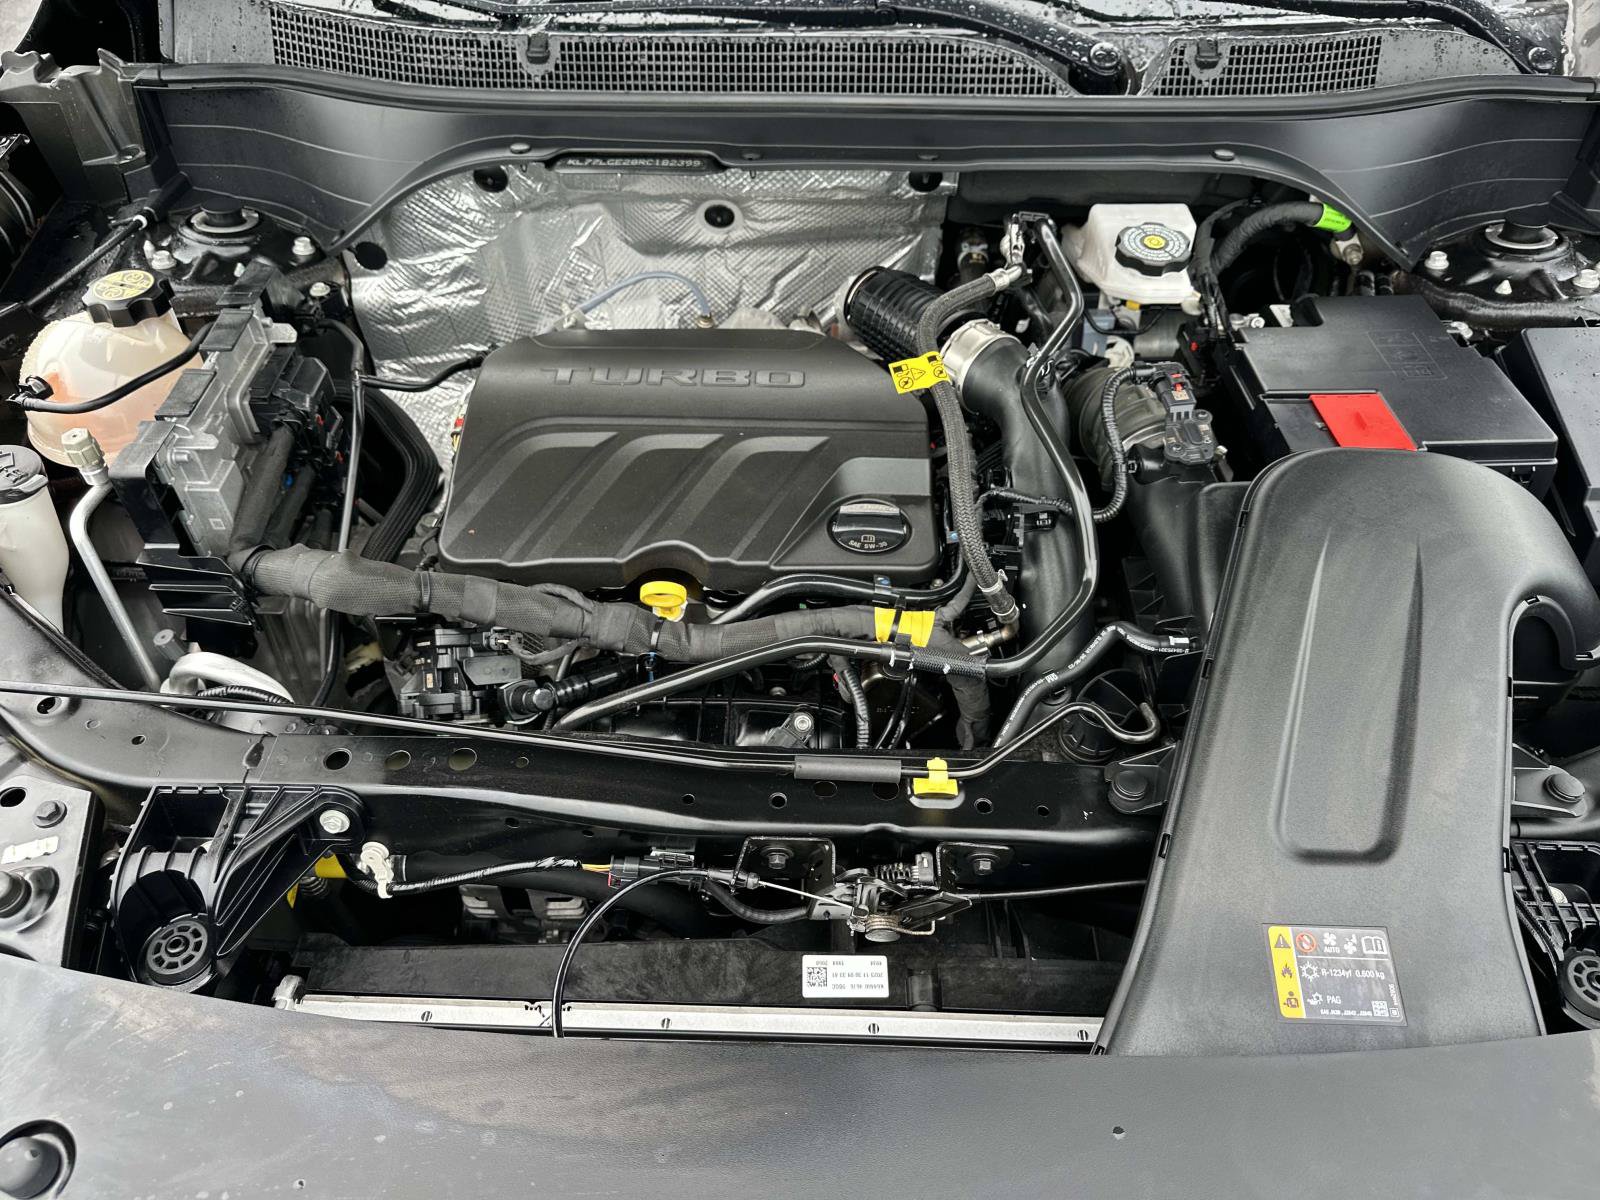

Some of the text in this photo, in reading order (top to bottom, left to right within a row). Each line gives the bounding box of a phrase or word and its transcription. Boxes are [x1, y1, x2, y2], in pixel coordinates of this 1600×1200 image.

[540, 366, 806, 388] TURBO
[1321, 968, 1352, 979] R-1234yf
[1326, 995, 1342, 1005] PAG
